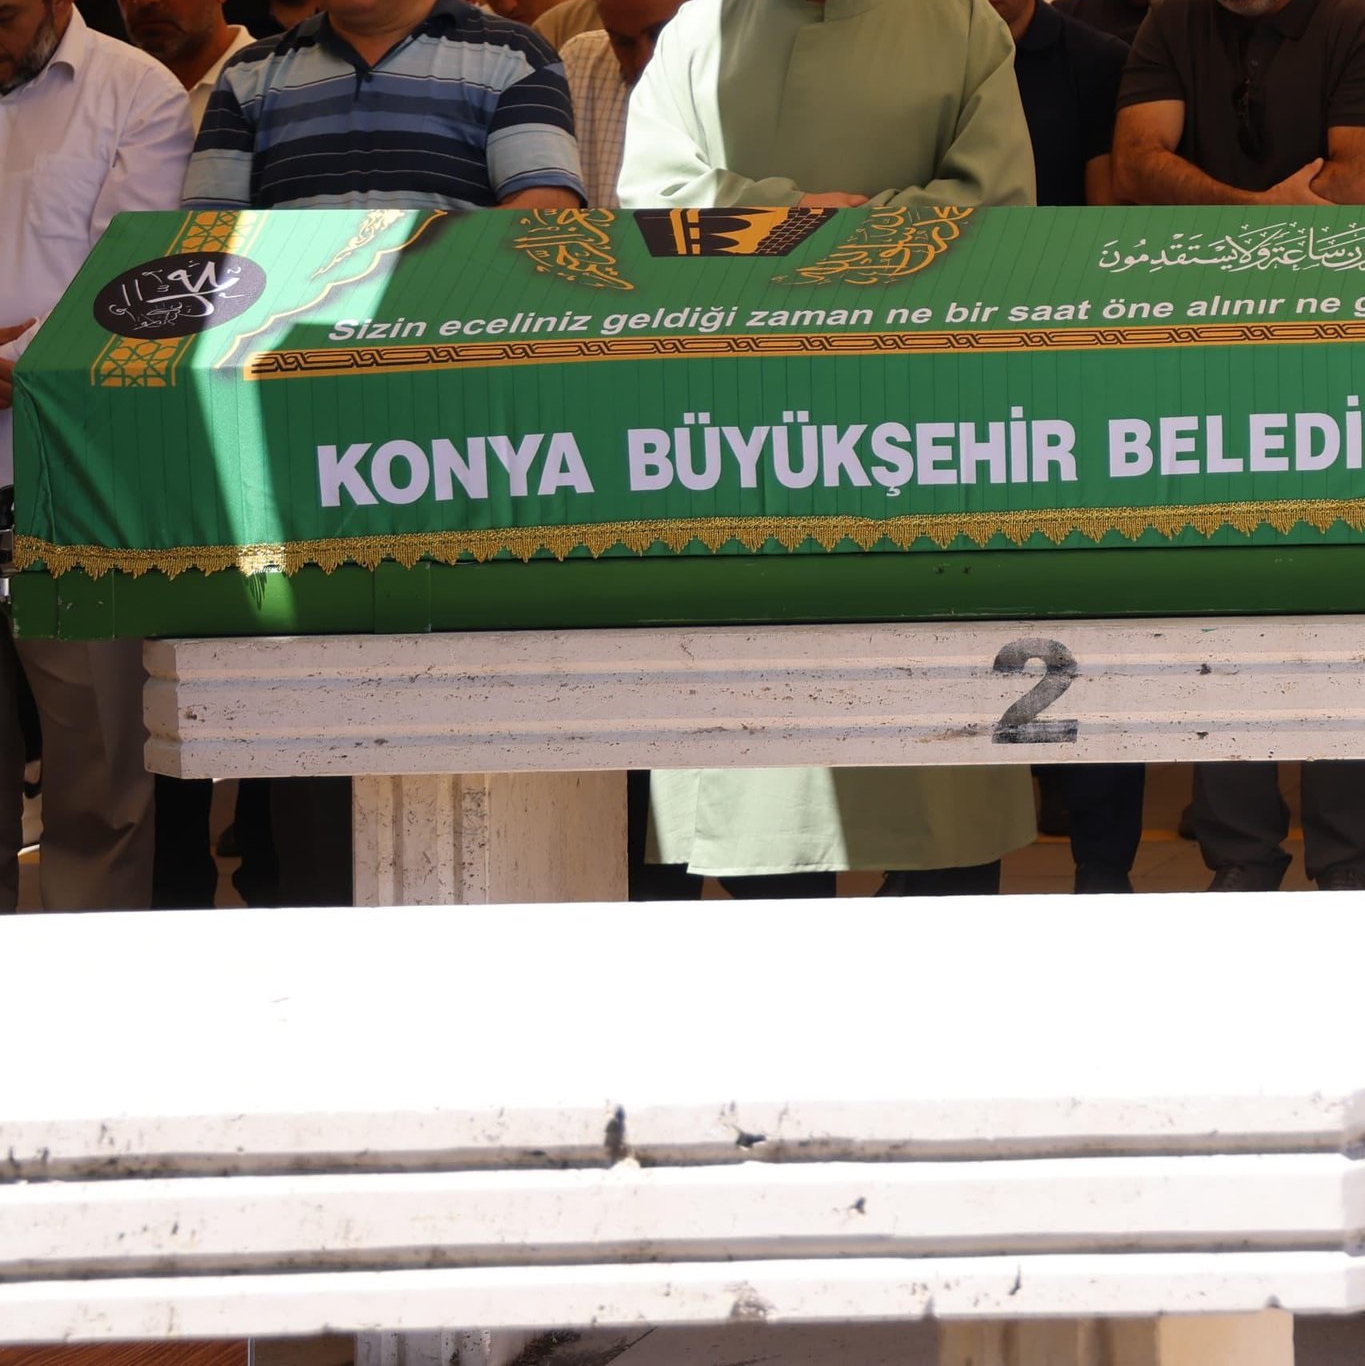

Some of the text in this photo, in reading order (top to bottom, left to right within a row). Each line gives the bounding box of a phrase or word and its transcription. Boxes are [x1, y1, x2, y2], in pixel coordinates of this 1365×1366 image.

[329, 316, 426, 341] Sizin
[439, 310, 592, 336] eceliniz
[600, 306, 738, 336] geldiği
[745, 306, 873, 327] zaman
[886, 307, 932, 325] ne
[945, 302, 999, 323] bir
[1007, 299, 1091, 322] saat
[1102, 298, 1174, 320] öne
[1186, 295, 1285, 318] alınır
[1296, 297, 1342, 315] ne
[317, 432, 595, 509] KONYA
[627, 406, 1078, 498] BÜYÜKŞEHİR
[991, 637, 1079, 744] 2
